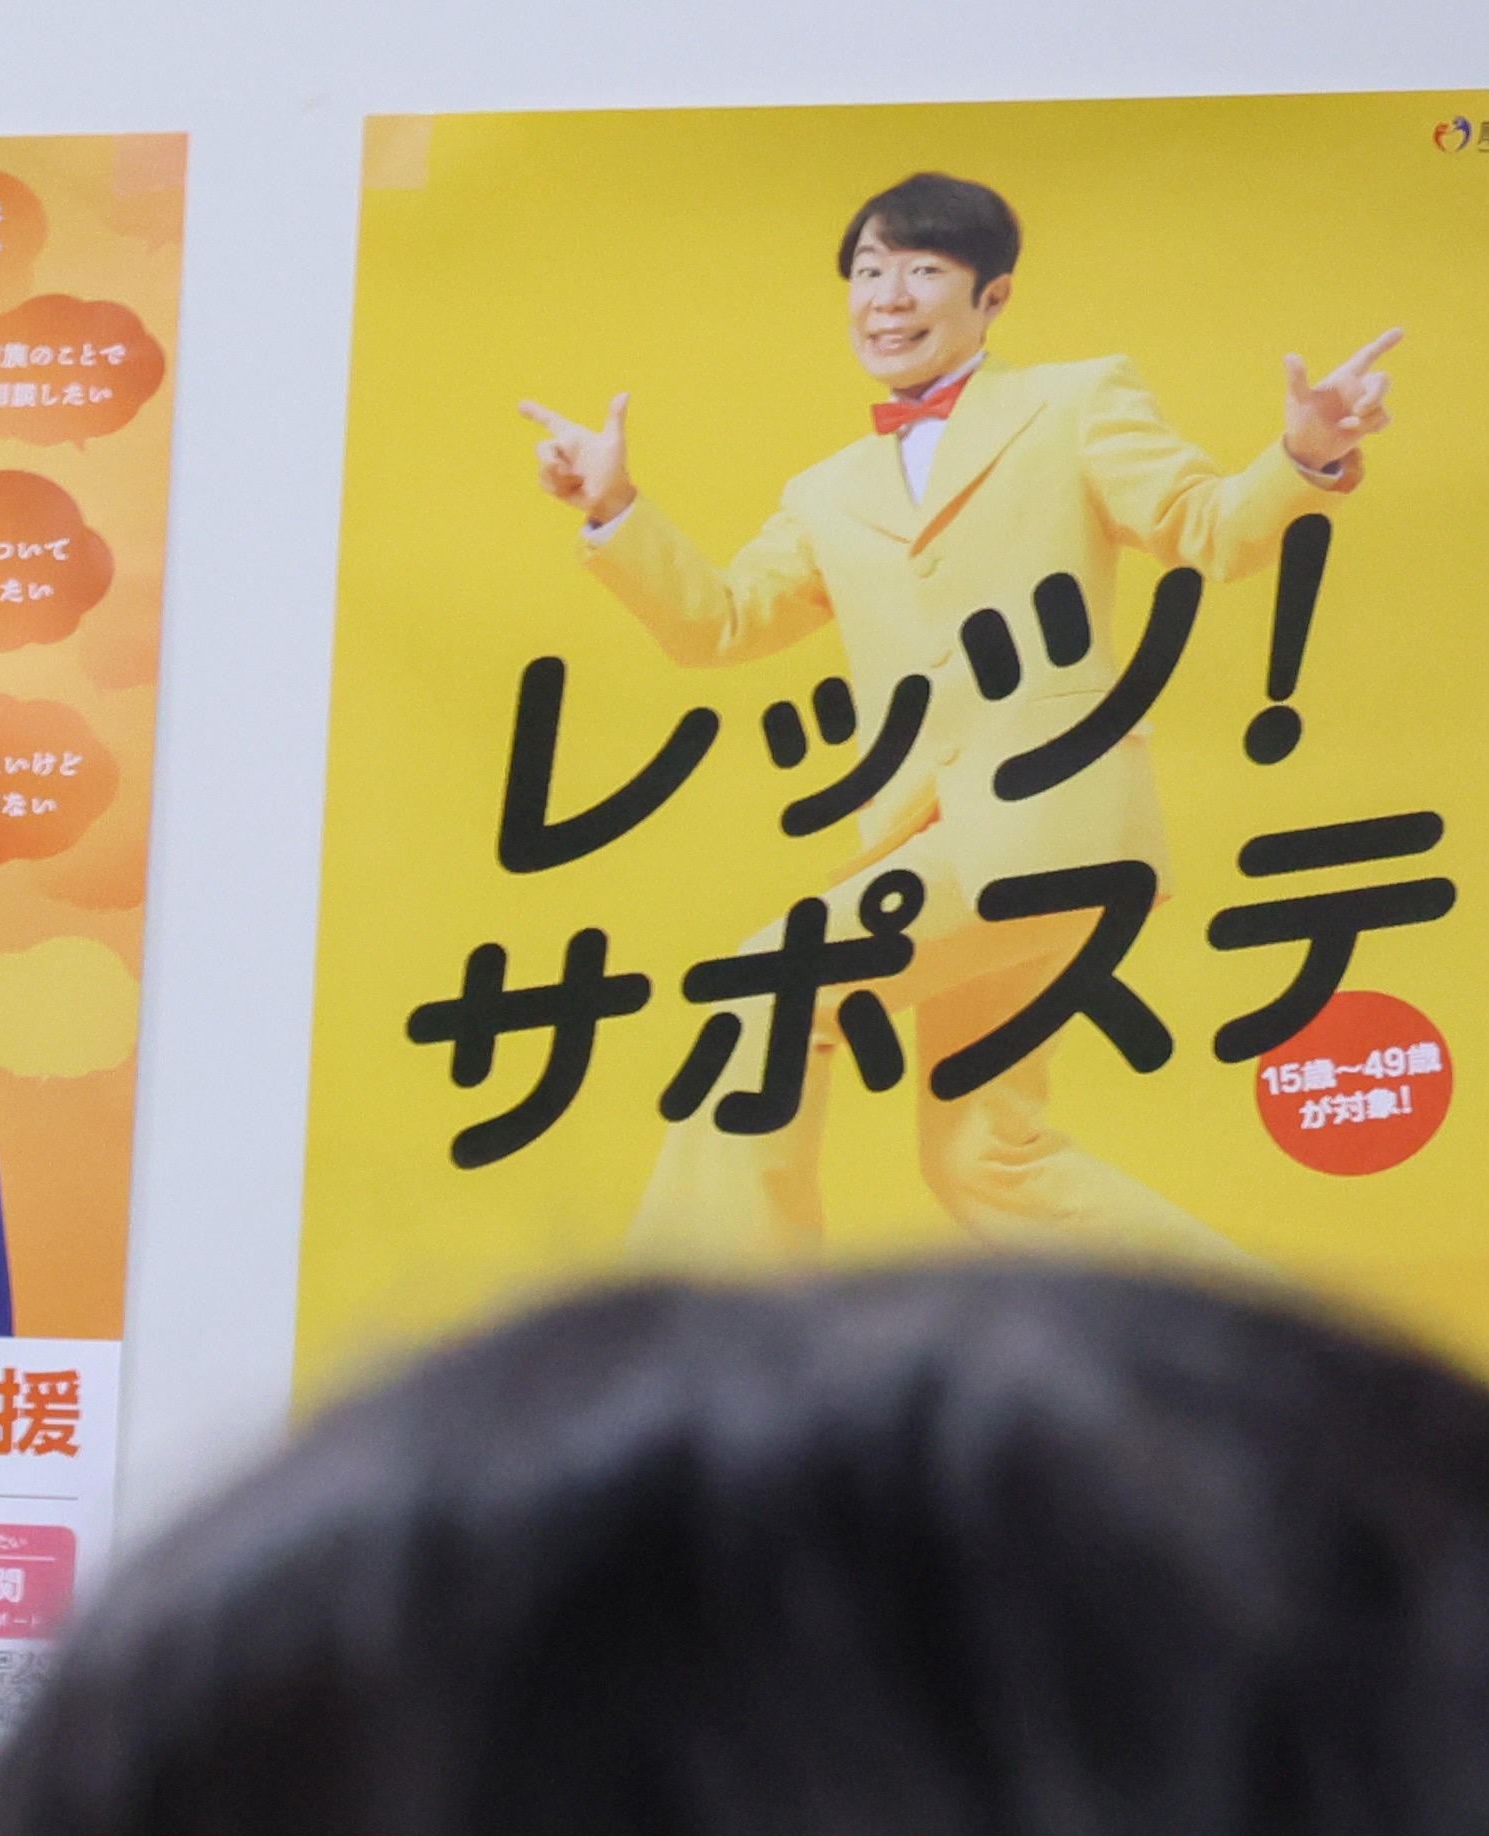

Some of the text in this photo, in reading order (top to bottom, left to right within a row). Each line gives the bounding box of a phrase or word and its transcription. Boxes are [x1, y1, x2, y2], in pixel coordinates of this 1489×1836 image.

[497, 512, 1333, 875] レッツ！
[406, 810, 1458, 1170] サポステ
